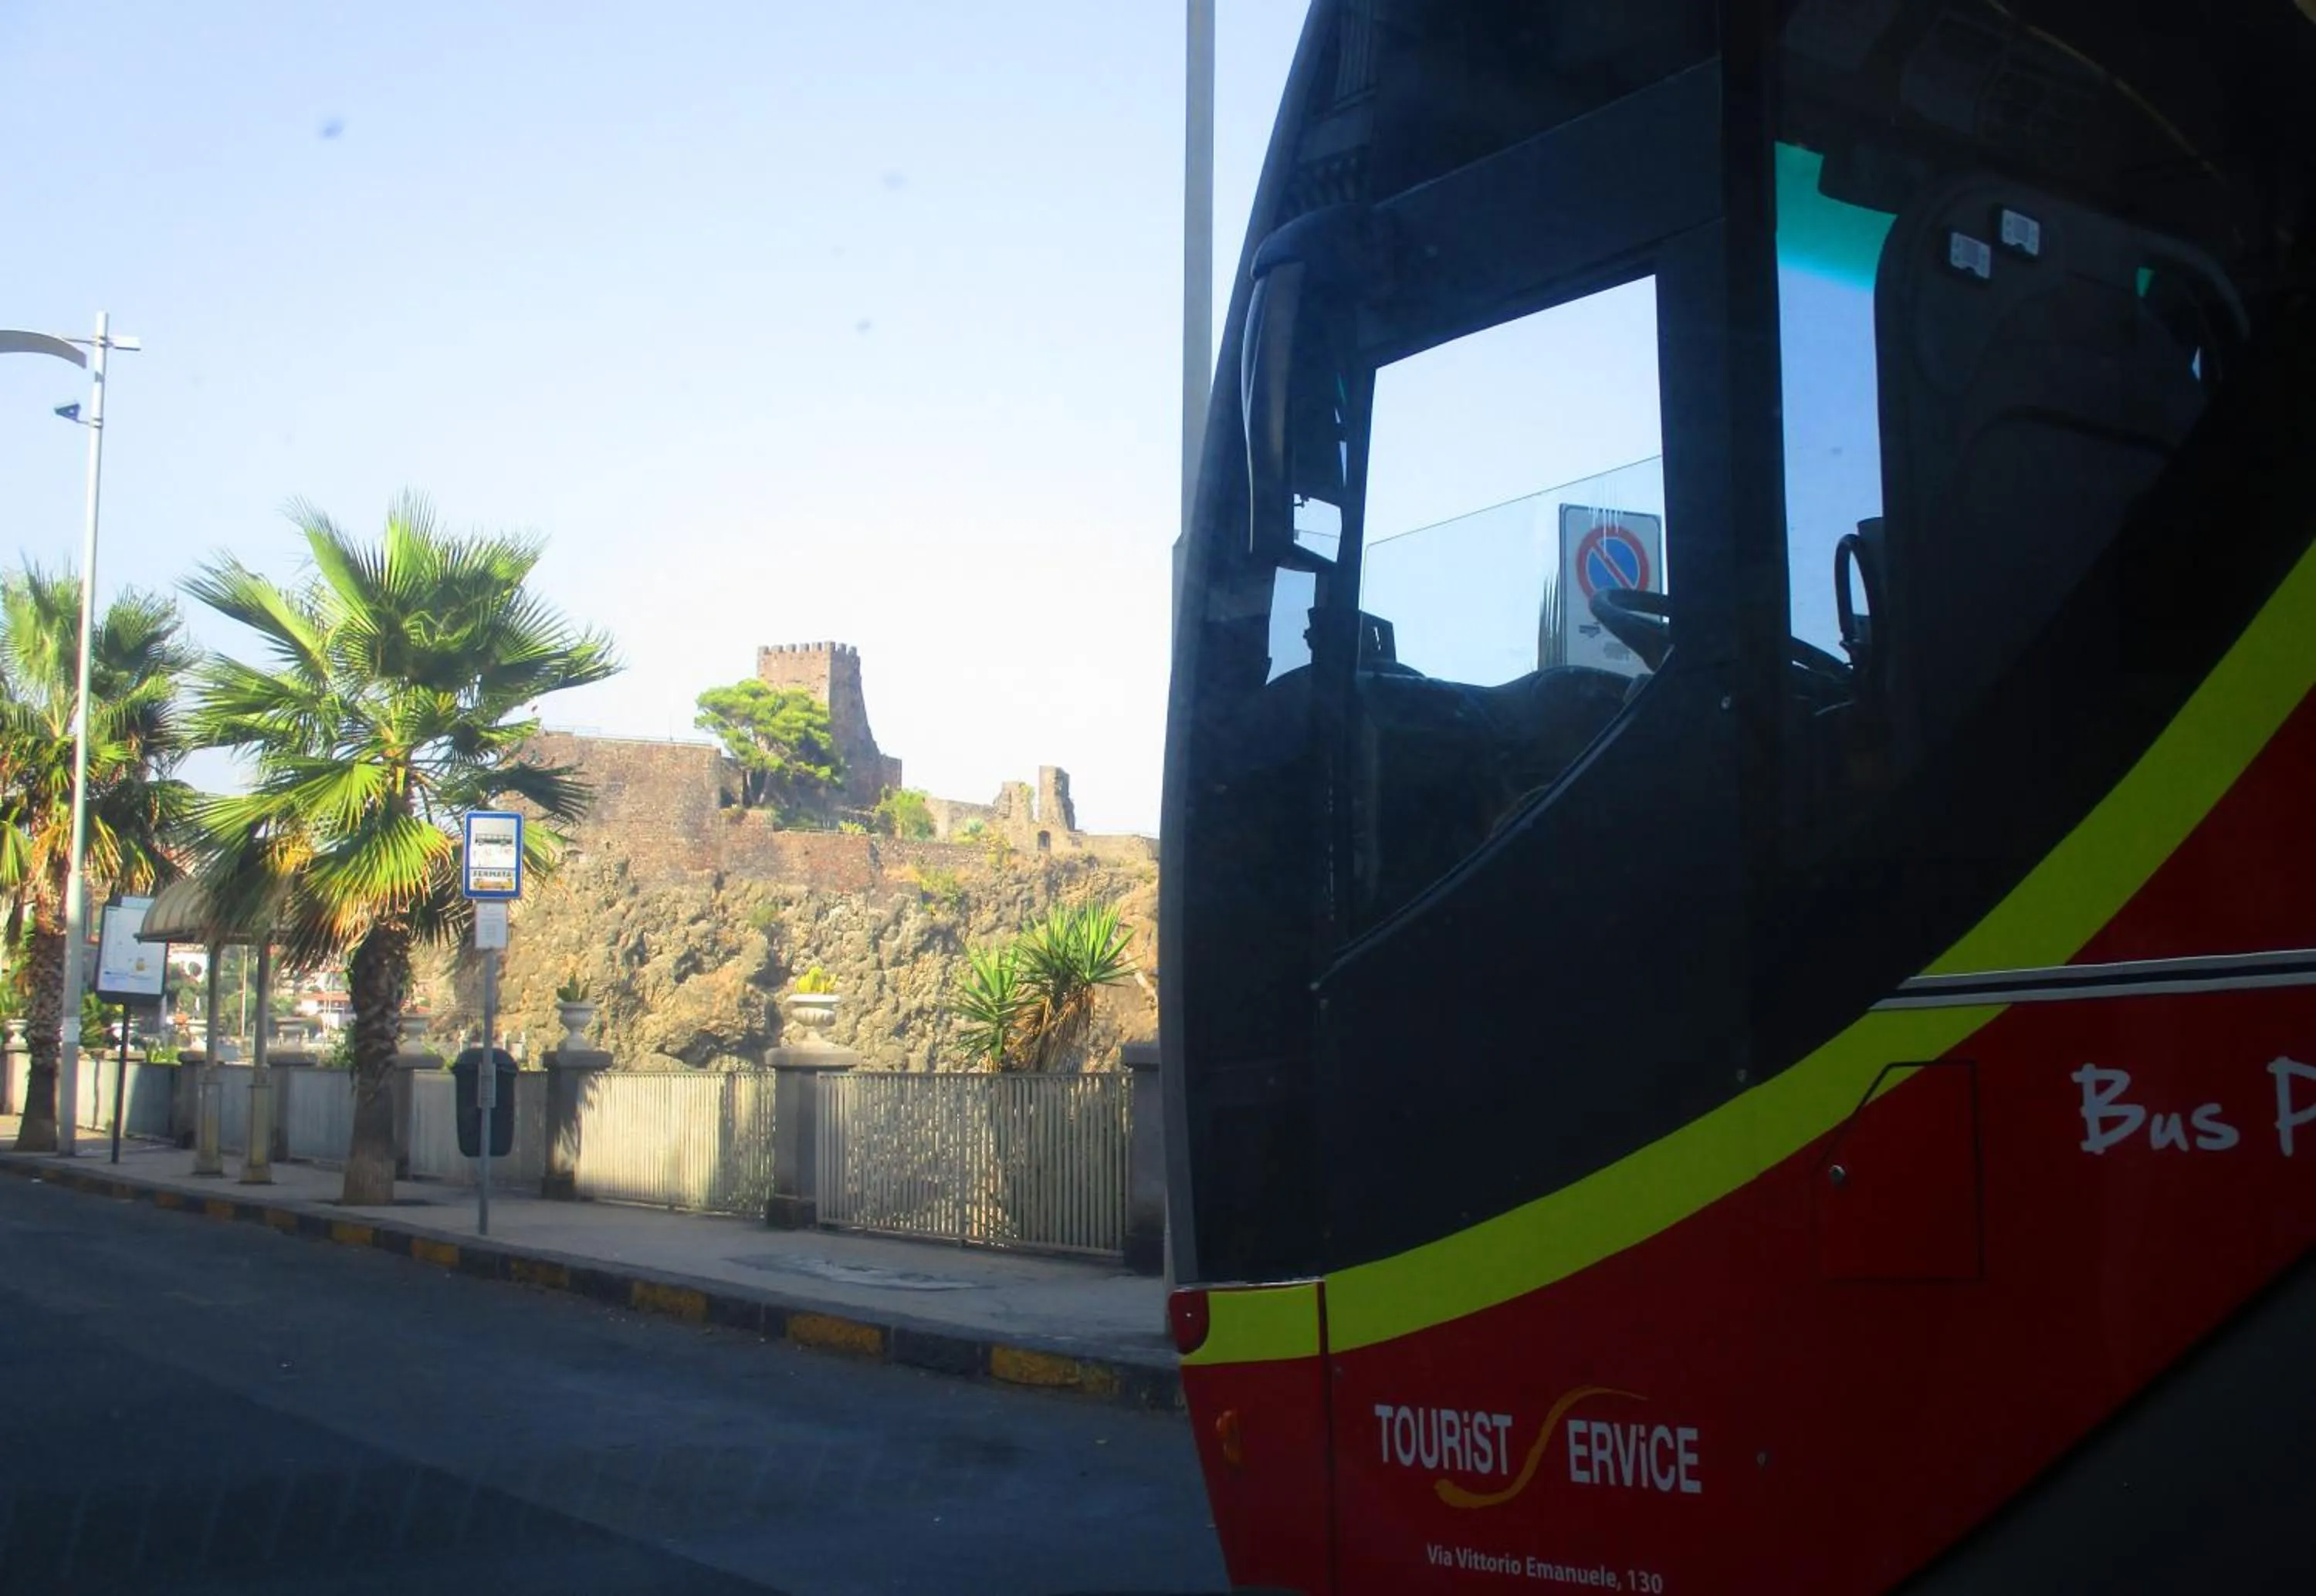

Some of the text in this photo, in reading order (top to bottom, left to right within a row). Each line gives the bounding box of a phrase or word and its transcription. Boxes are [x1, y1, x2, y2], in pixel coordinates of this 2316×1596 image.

[2071, 1063, 2240, 1155] Bus
[1427, 1542, 1664, 1594] Via Vittorio Emanuele, 130
